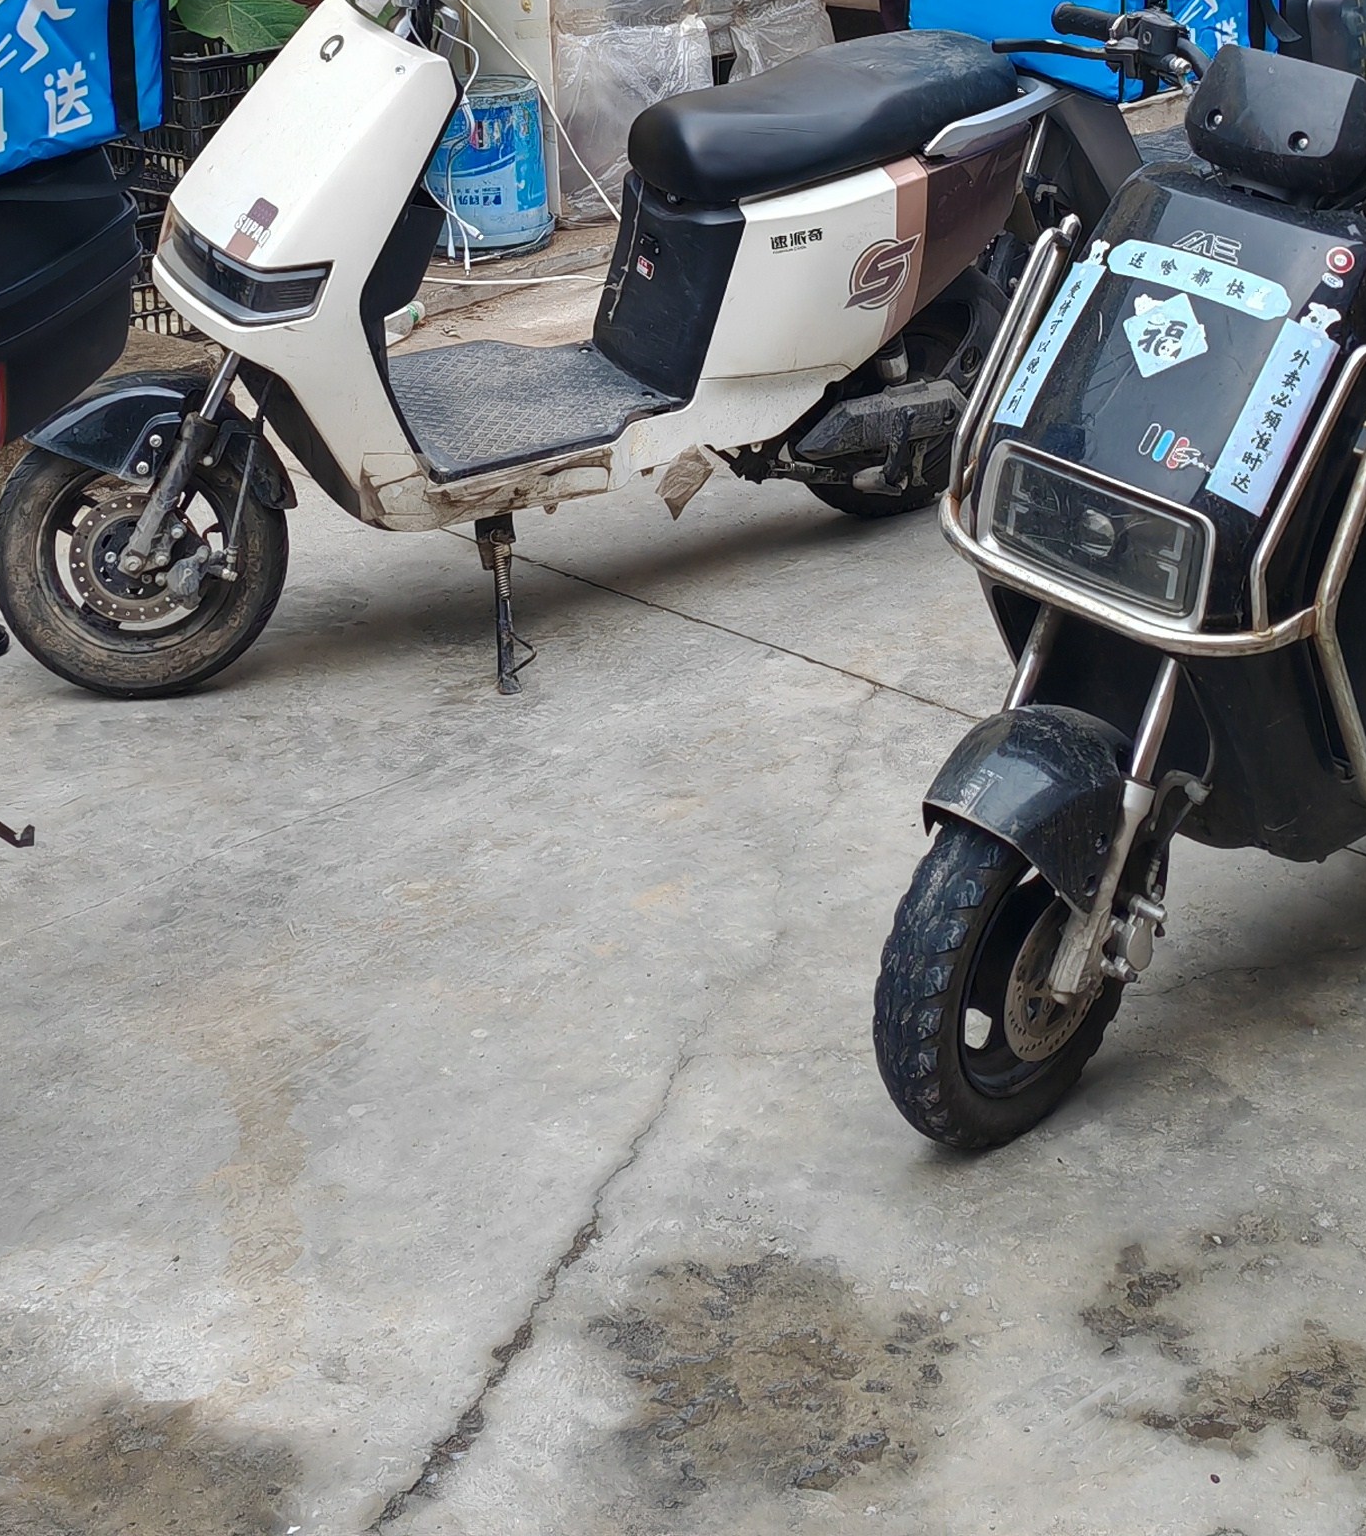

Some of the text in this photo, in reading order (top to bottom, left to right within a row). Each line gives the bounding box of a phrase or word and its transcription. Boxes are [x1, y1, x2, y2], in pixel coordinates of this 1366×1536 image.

[770, 227, 823, 250] 速派奇
[1128, 250, 1246, 300] 送啥都快
[1137, 319, 1188, 361] 福
[1230, 349, 1311, 495] 外卖必须准时达
